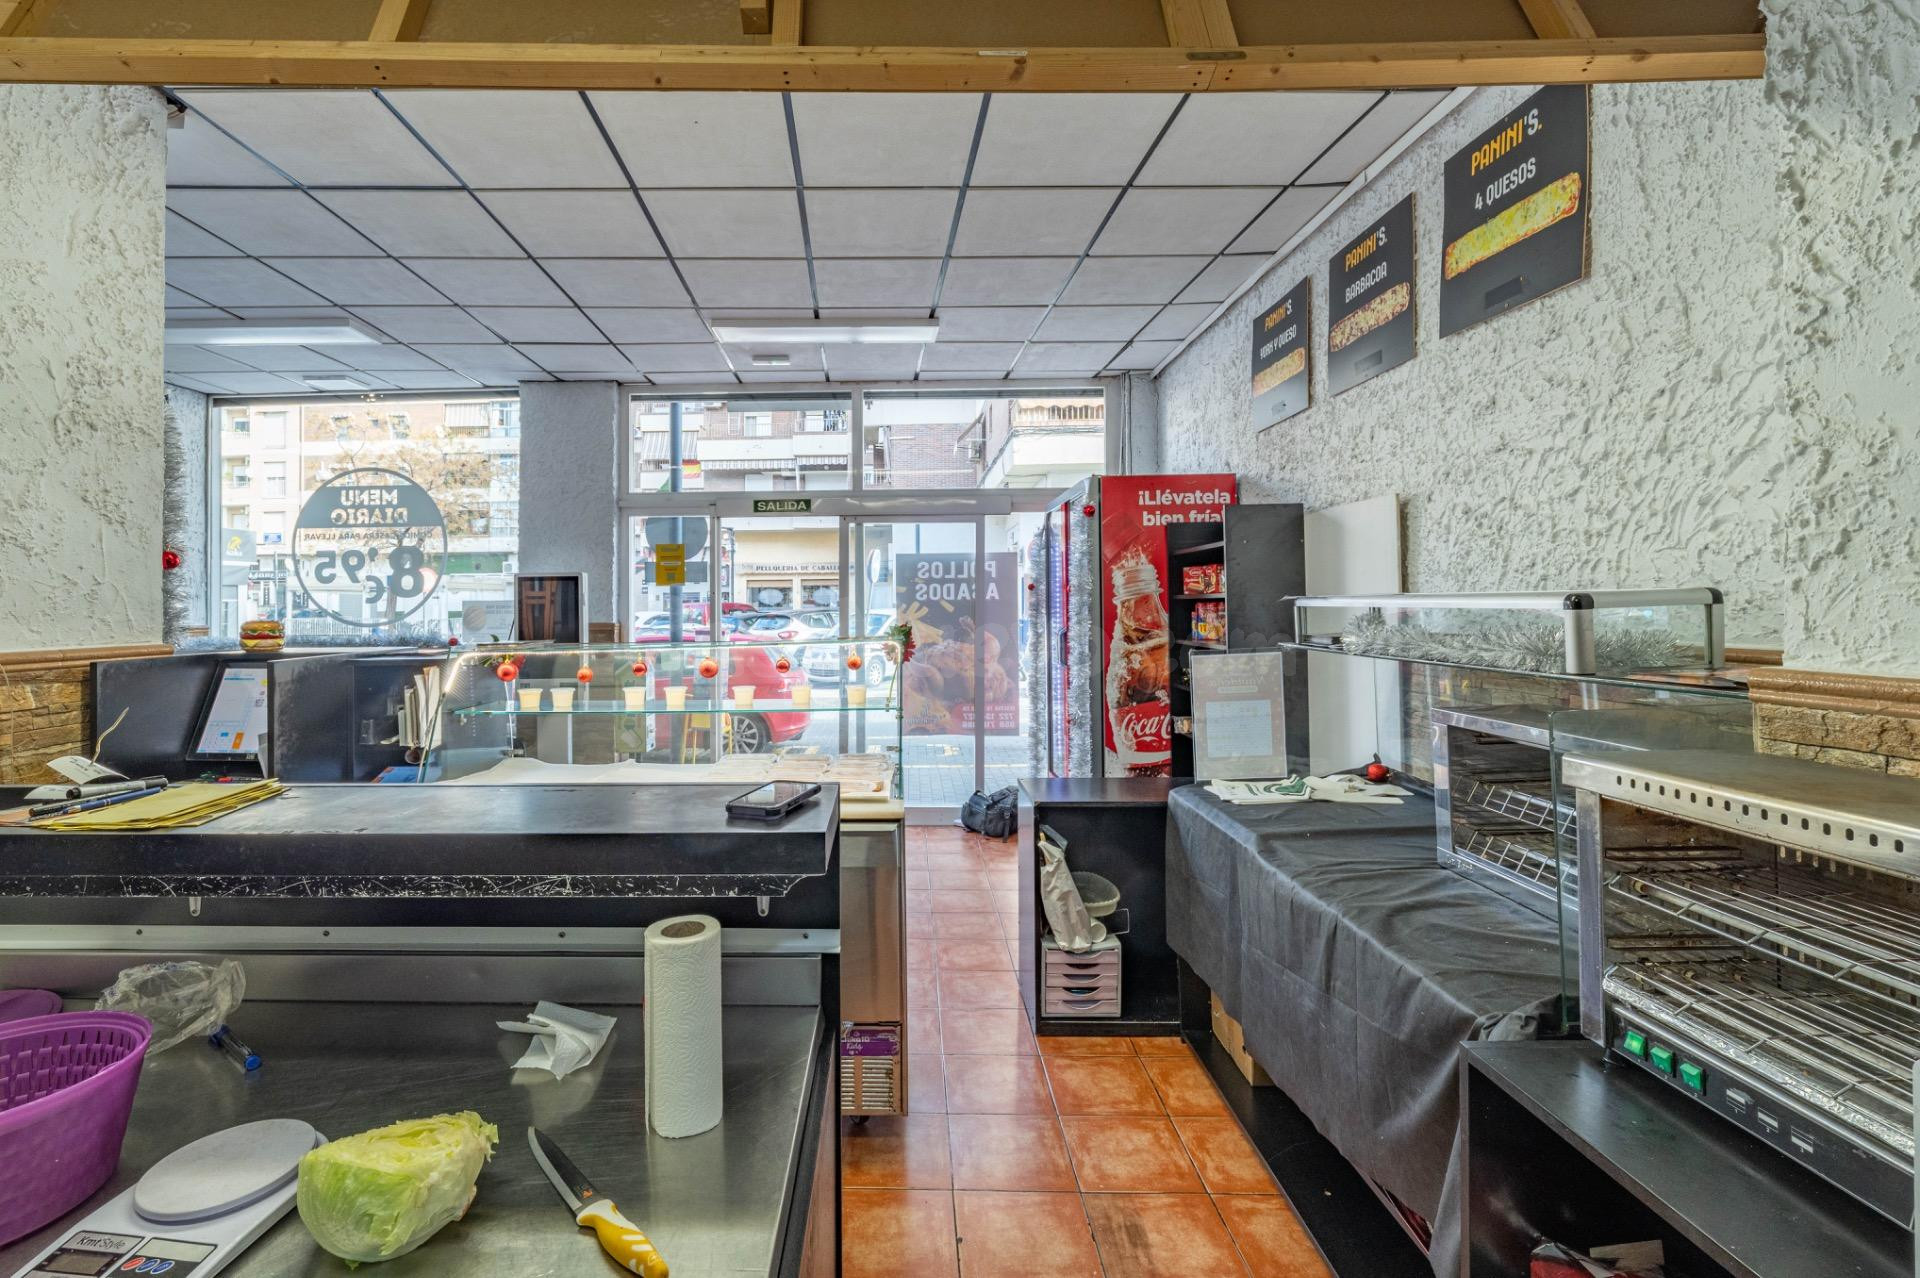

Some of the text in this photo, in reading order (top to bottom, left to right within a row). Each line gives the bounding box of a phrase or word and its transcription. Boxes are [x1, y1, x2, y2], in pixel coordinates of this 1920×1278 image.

[1474, 157, 1536, 210] 4 QUESOS
[1345, 261, 1387, 304] BARBACOA
[1278, 324, 1297, 348] QUESO
[757, 501, 807, 511] SALIDA
[1138, 488, 1231, 505] ¡Llévatela
[1143, 510, 1184, 526] bien
